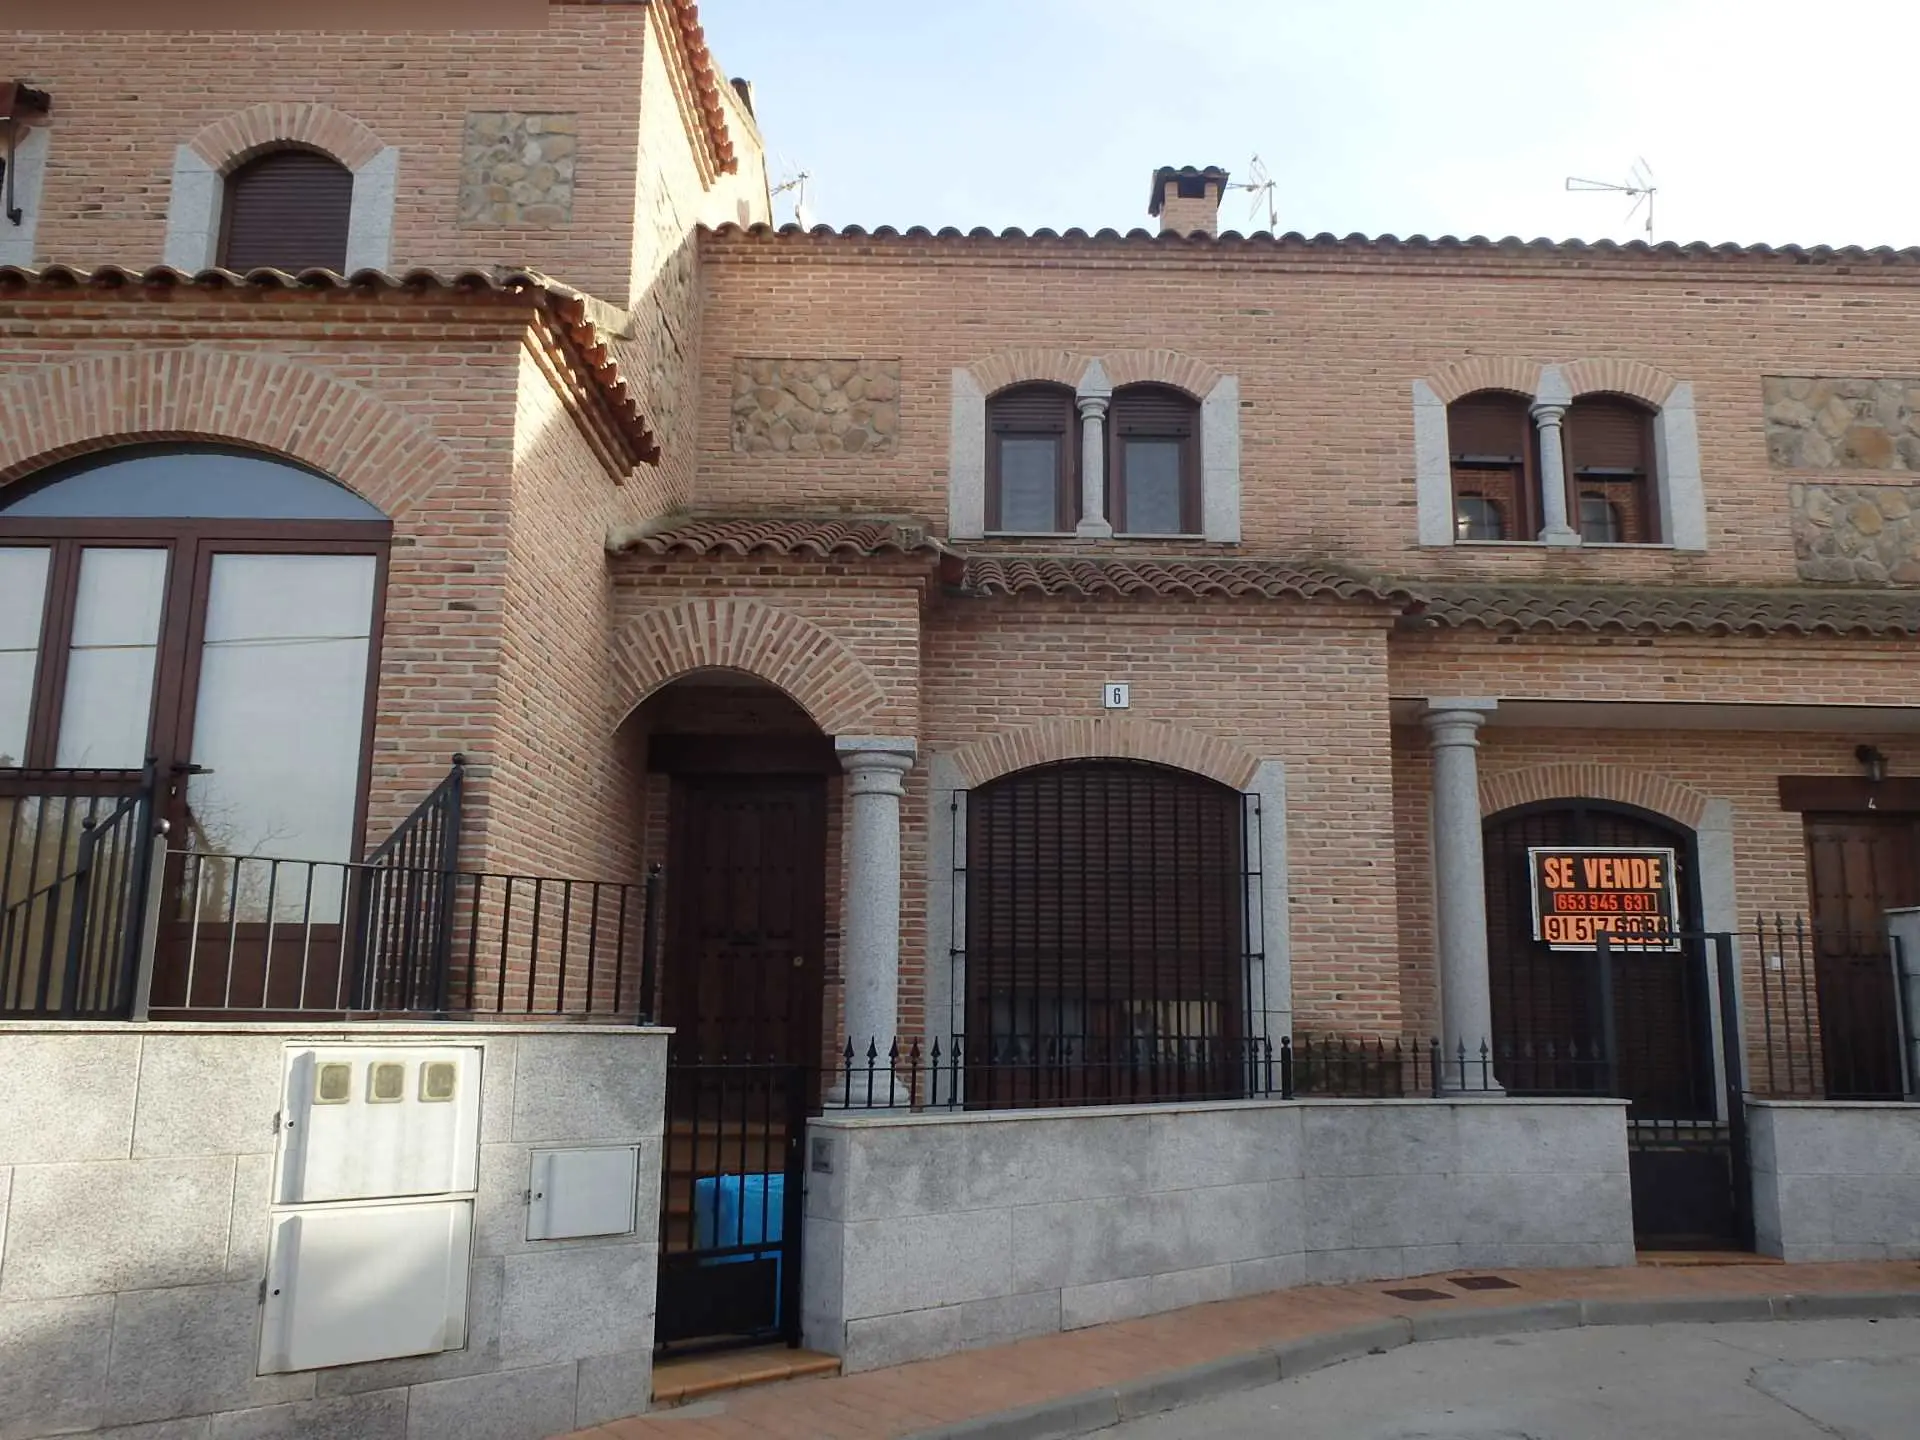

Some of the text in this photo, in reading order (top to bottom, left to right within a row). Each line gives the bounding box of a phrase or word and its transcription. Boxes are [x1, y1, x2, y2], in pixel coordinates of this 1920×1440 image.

[1113, 687, 1121, 705] 6
[1544, 857, 1663, 889] SE VENDE
[1558, 894, 1650, 911] 653 945 631
[1548, 917, 1569, 941] 91
